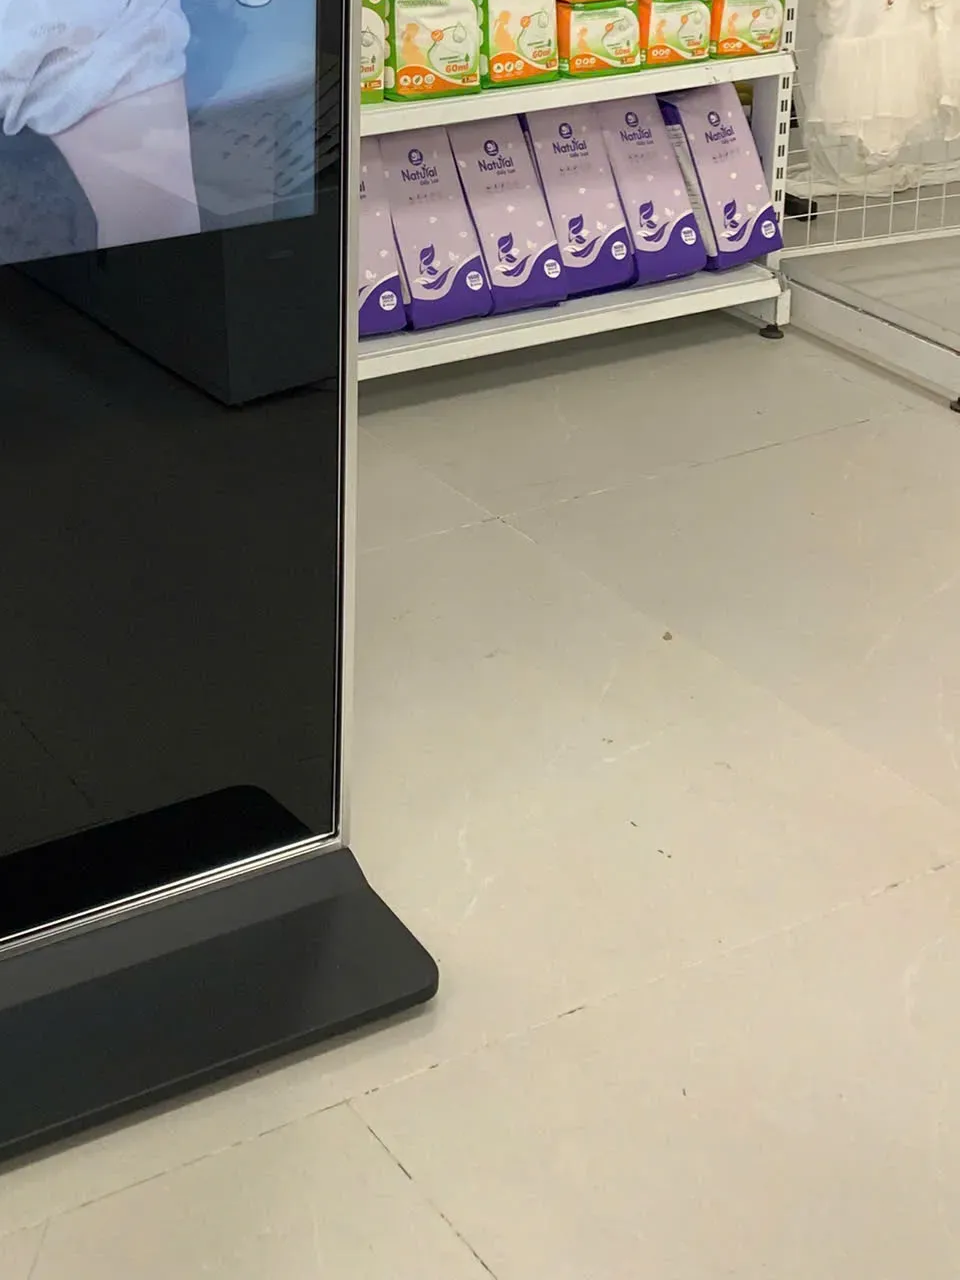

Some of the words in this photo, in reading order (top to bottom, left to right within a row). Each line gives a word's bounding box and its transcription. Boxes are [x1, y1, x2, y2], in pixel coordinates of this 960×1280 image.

[445, 63, 470, 74] 60ml
[552, 138, 588, 154] Natural
[477, 155, 515, 172] Natural
[401, 165, 438, 183] Natural
